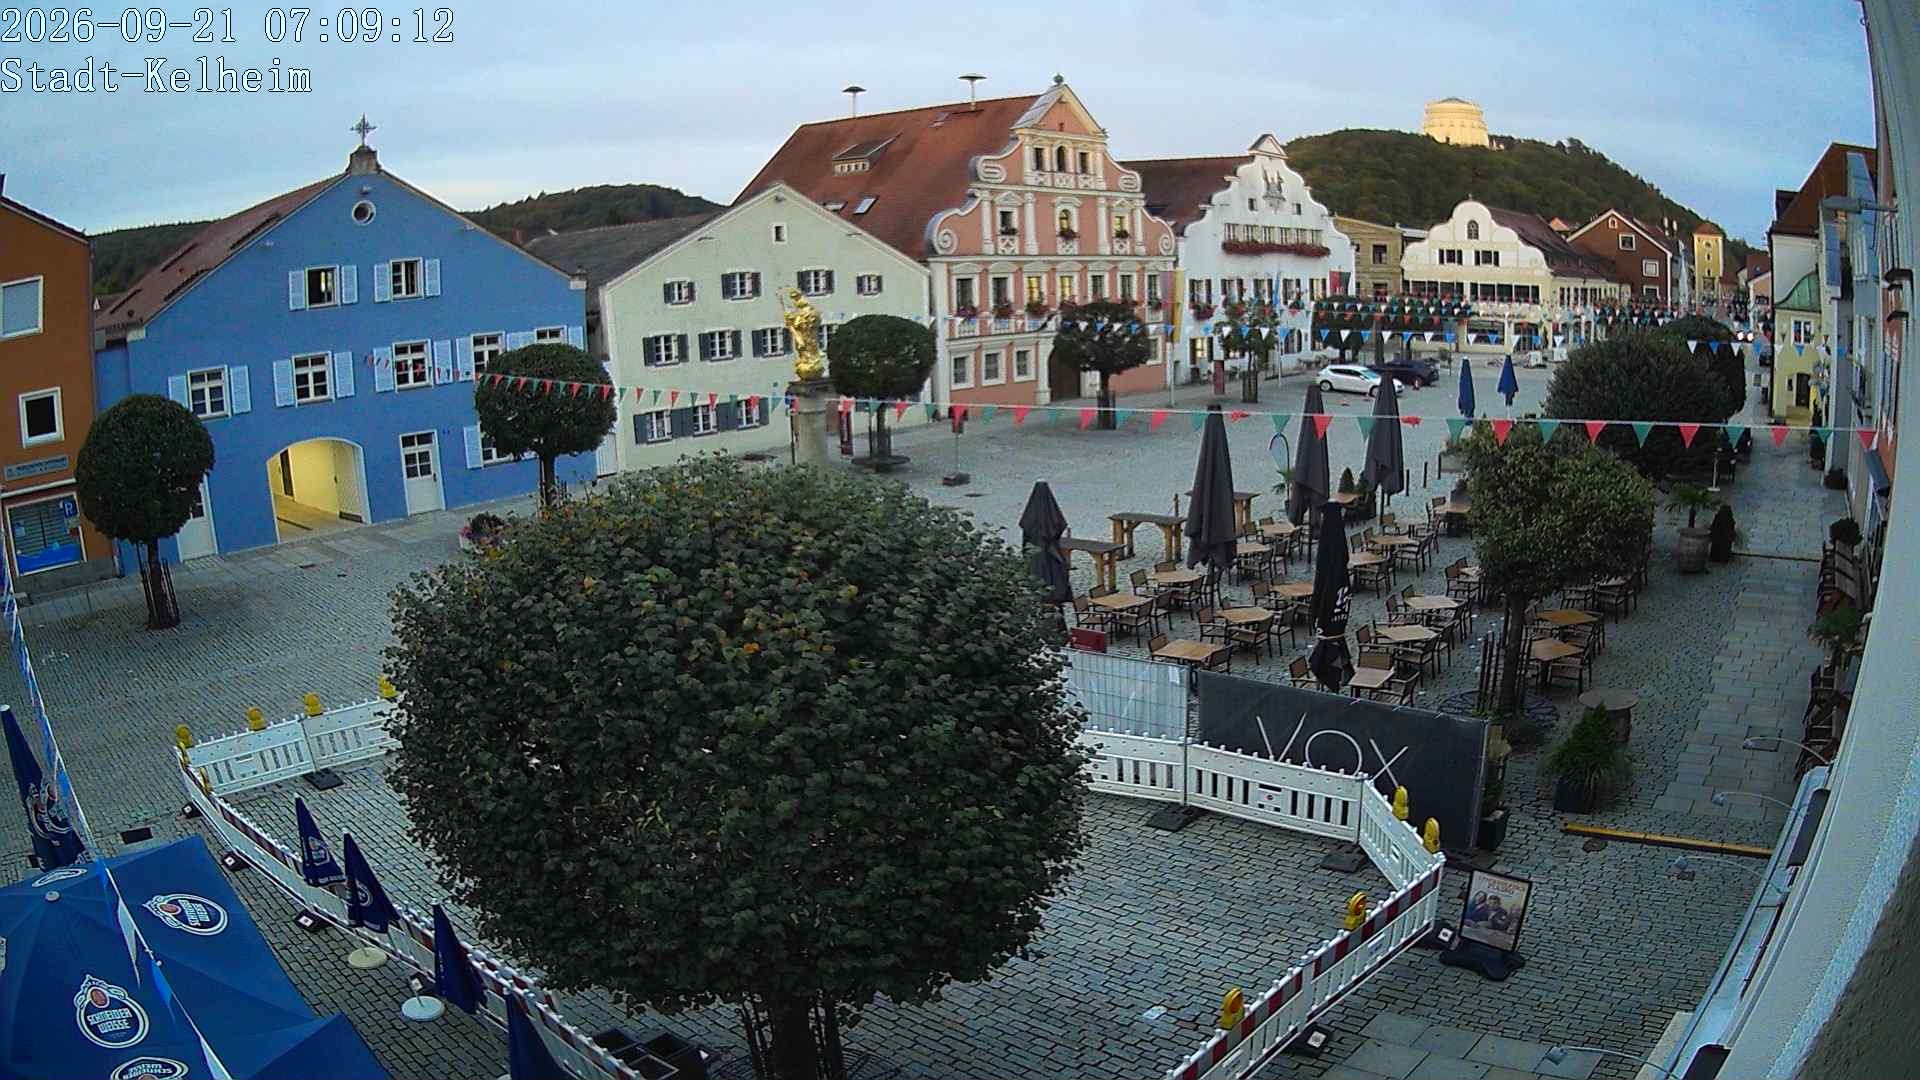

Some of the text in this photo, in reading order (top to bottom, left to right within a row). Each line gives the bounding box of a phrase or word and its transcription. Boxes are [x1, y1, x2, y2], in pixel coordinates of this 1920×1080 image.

[1256, 712, 1408, 789] VOX
[86, 1007, 133, 1026] SCHNEIDER
[97, 1019, 132, 1034] WEISSE
